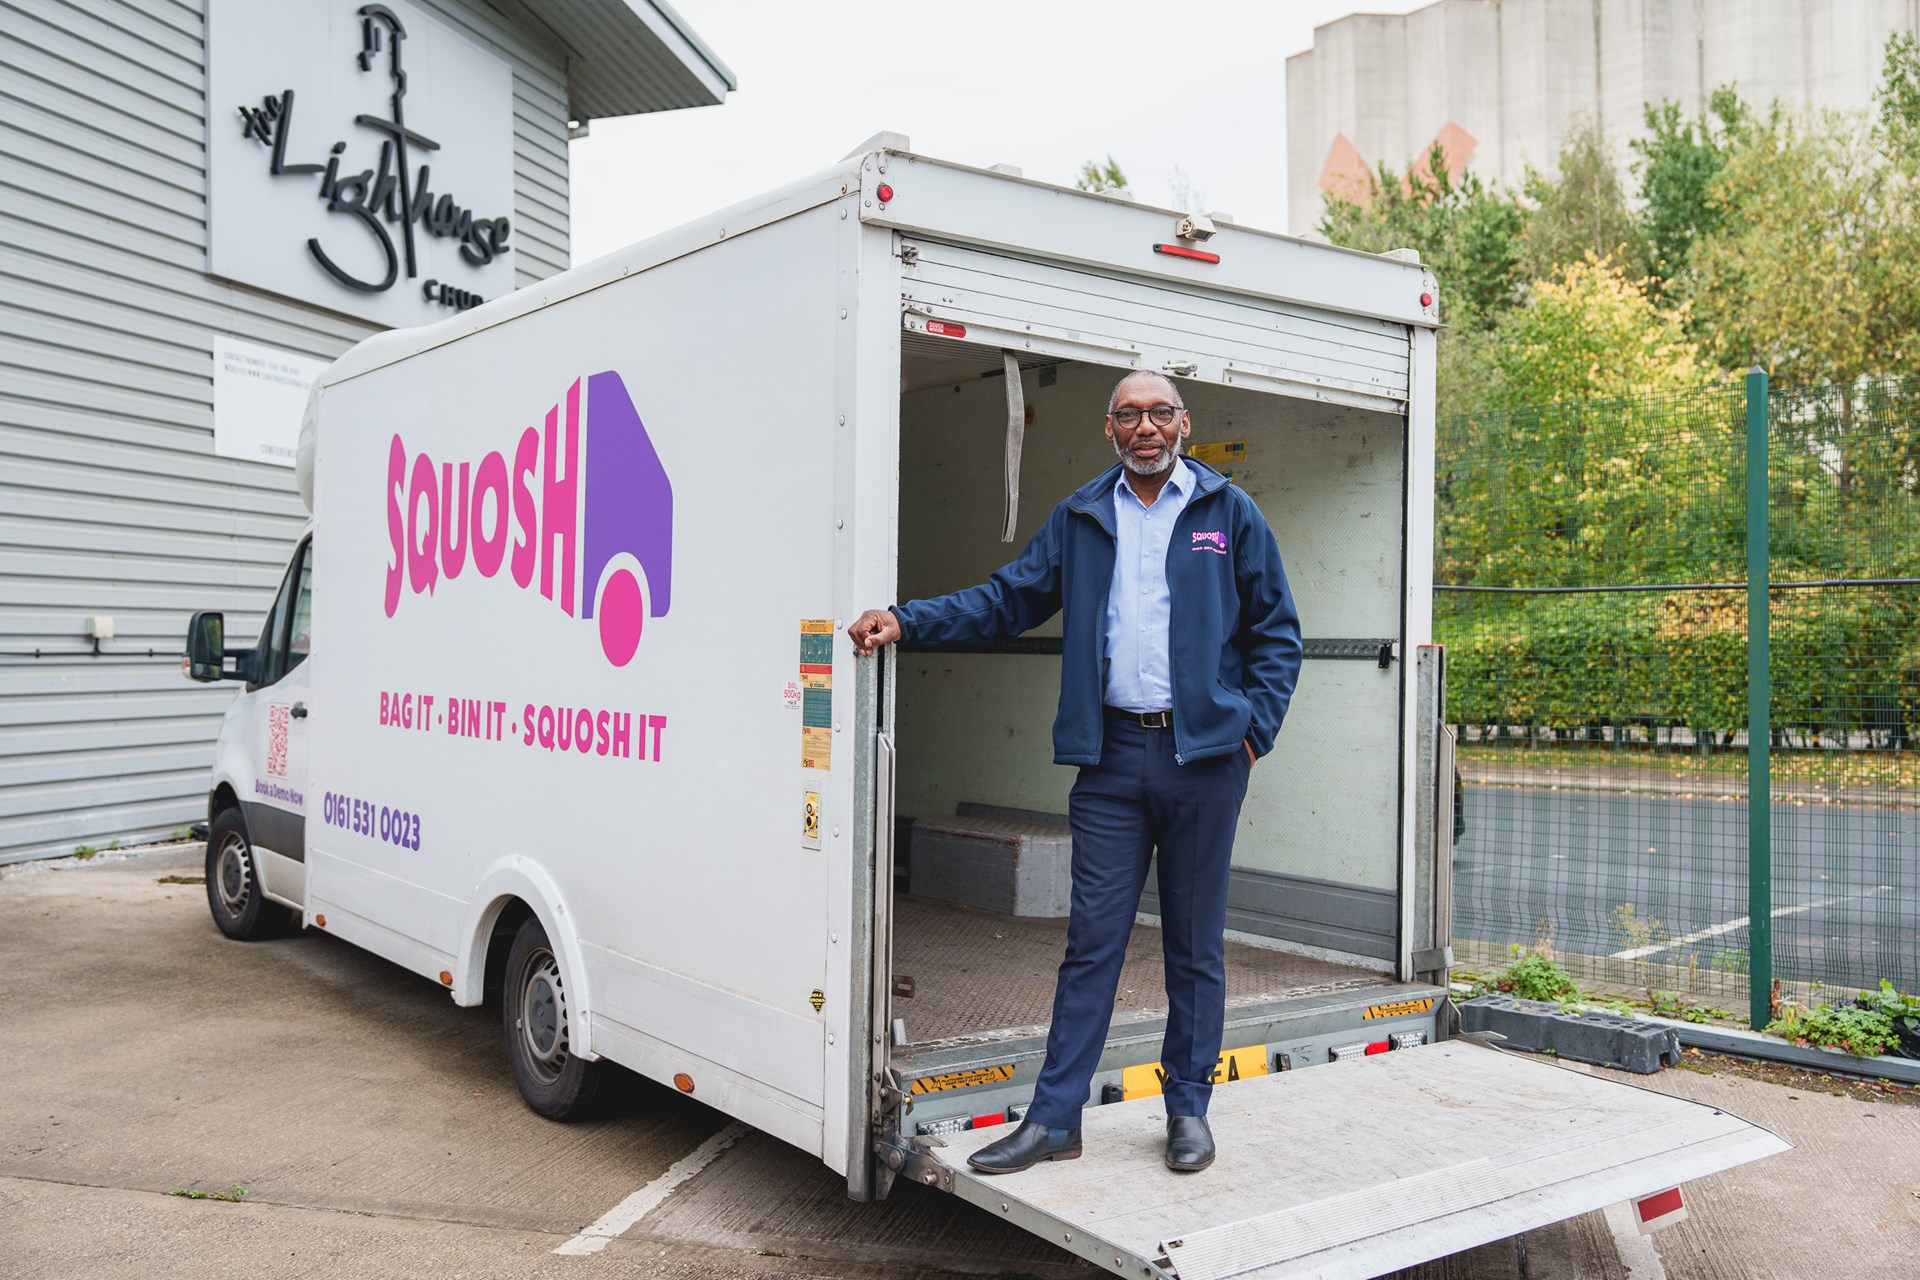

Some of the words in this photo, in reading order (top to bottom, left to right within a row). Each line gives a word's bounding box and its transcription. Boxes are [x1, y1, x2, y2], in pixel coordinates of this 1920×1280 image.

[423, 279, 484, 311] CHUR
[260, 444, 296, 458] CONFERENC
[385, 376, 580, 618] SQUOSH
[1192, 531, 1219, 545] SQUOSH
[380, 691, 412, 729] BAG
[417, 695, 434, 731] IT
[448, 698, 481, 738] BIN
[486, 701, 506, 741] IT
[523, 704, 631, 758] SQUOSH
[638, 714, 667, 762] IT
[255, 778, 269, 796] Book
[274, 783, 290, 801] Demo
[290, 788, 304, 806] Now
[324, 791, 350, 829] 0161
[353, 799, 375, 838] 531
[380, 806, 421, 851] 0023
